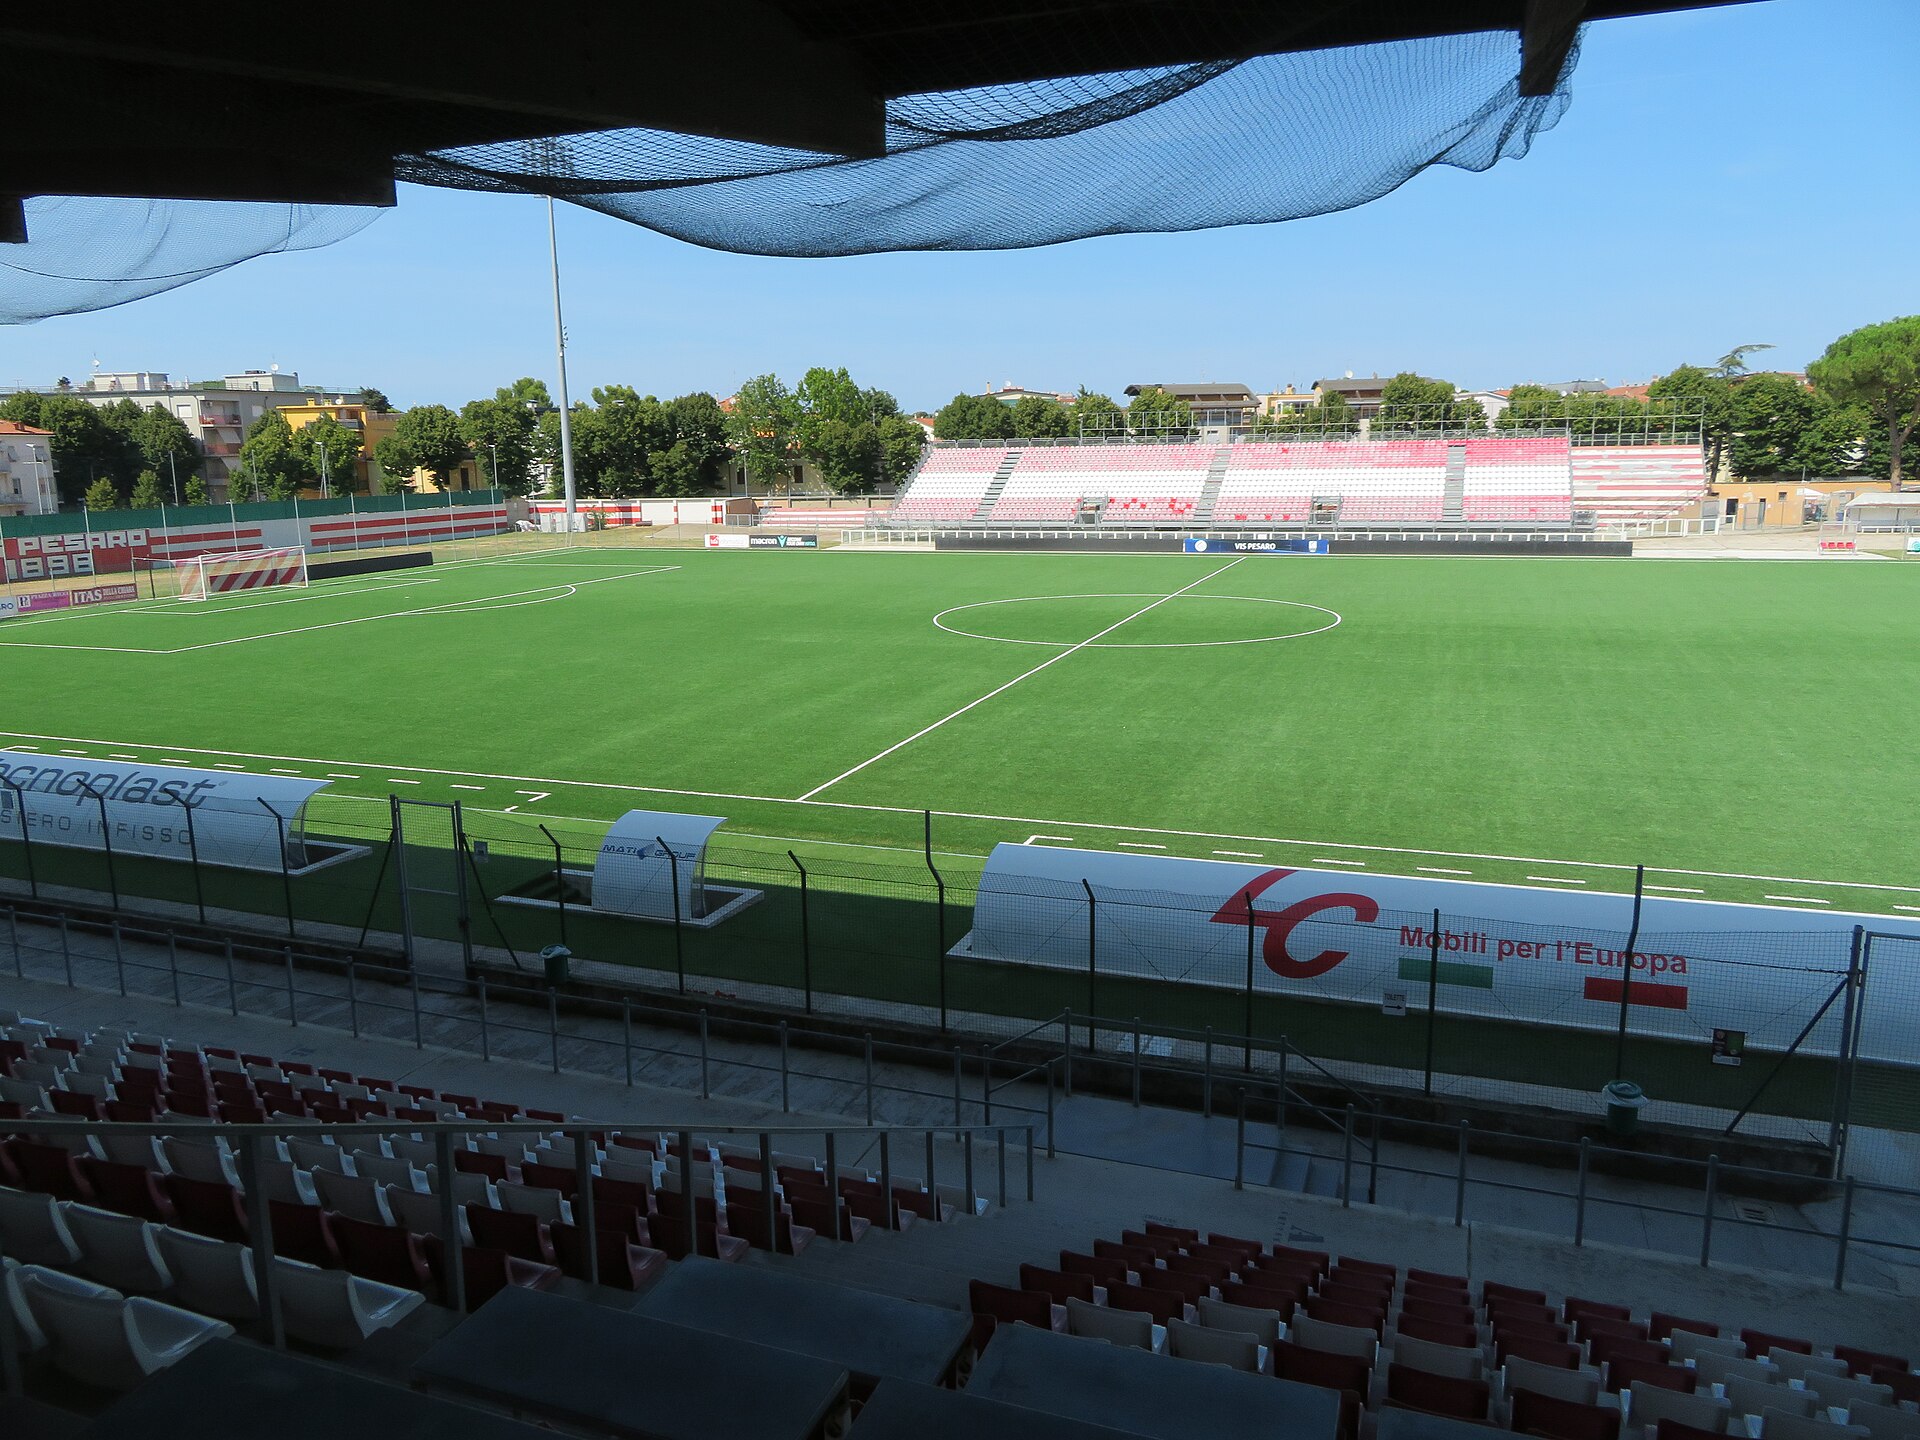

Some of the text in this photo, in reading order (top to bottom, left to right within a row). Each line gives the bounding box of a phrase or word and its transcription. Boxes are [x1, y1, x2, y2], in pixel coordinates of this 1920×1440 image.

[17, 529, 147, 555] PESARO
[1234, 542, 1276, 550] VIS PESARO
[7, 553, 93, 579] 1898
[0, 601, 14, 610] RO
[74, 590, 102, 604] ITAS
[1399, 925, 1688, 976] Mobili per l'Europa
